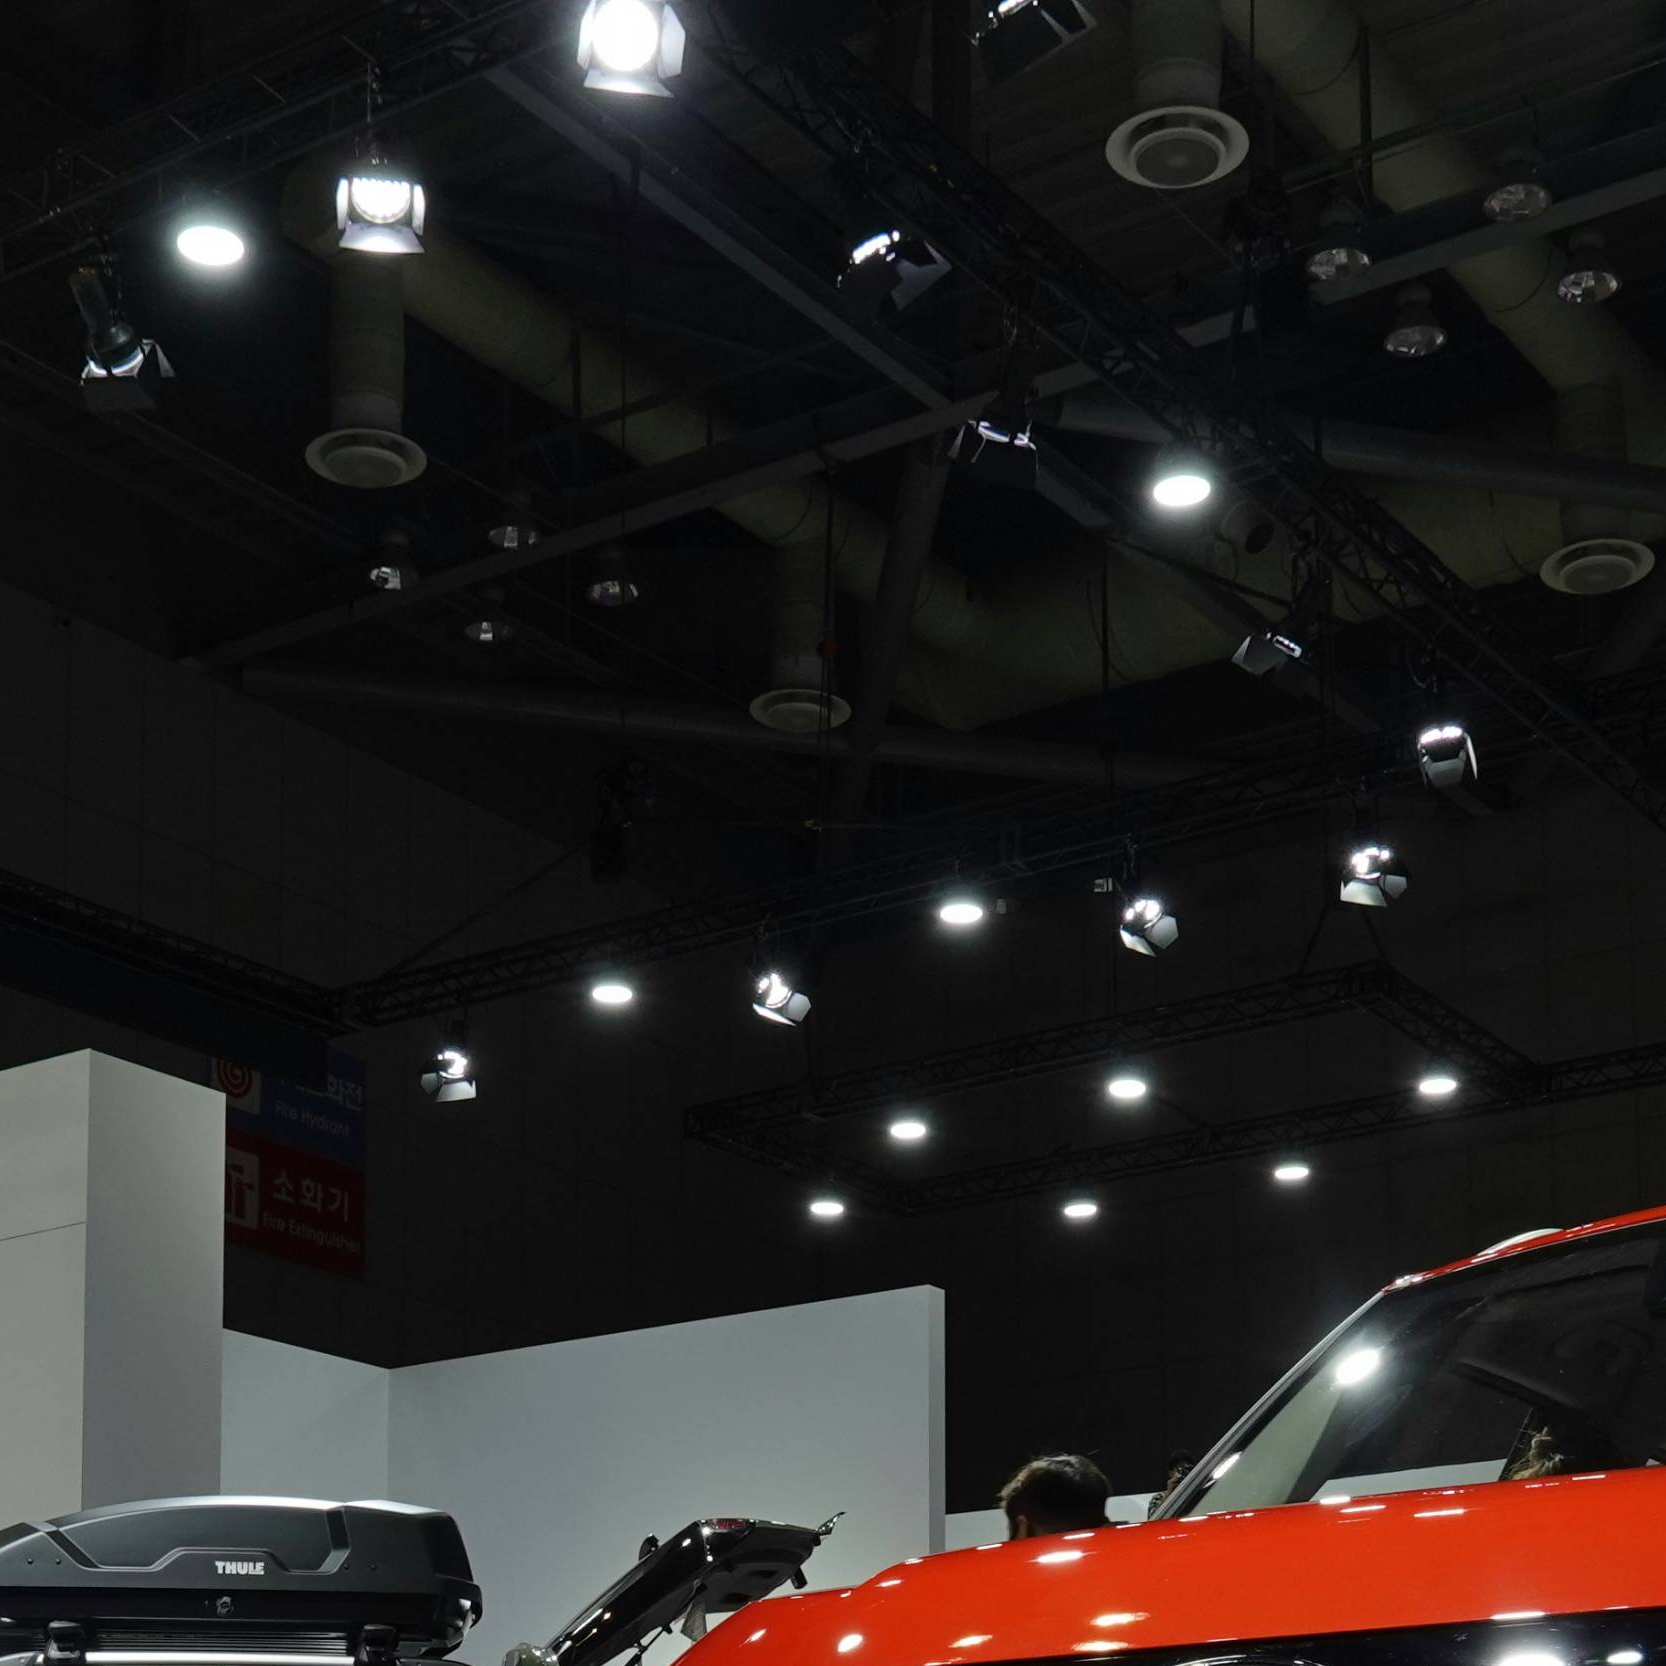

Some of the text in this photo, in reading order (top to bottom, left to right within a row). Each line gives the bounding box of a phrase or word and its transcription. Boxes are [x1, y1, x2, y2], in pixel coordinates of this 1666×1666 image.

[275, 1098, 350, 1137] Fire Hydrant
[272, 1168, 350, 1223] 소화기
[262, 1211, 286, 1232] Fire
[215, 1560, 265, 1575] THULE
